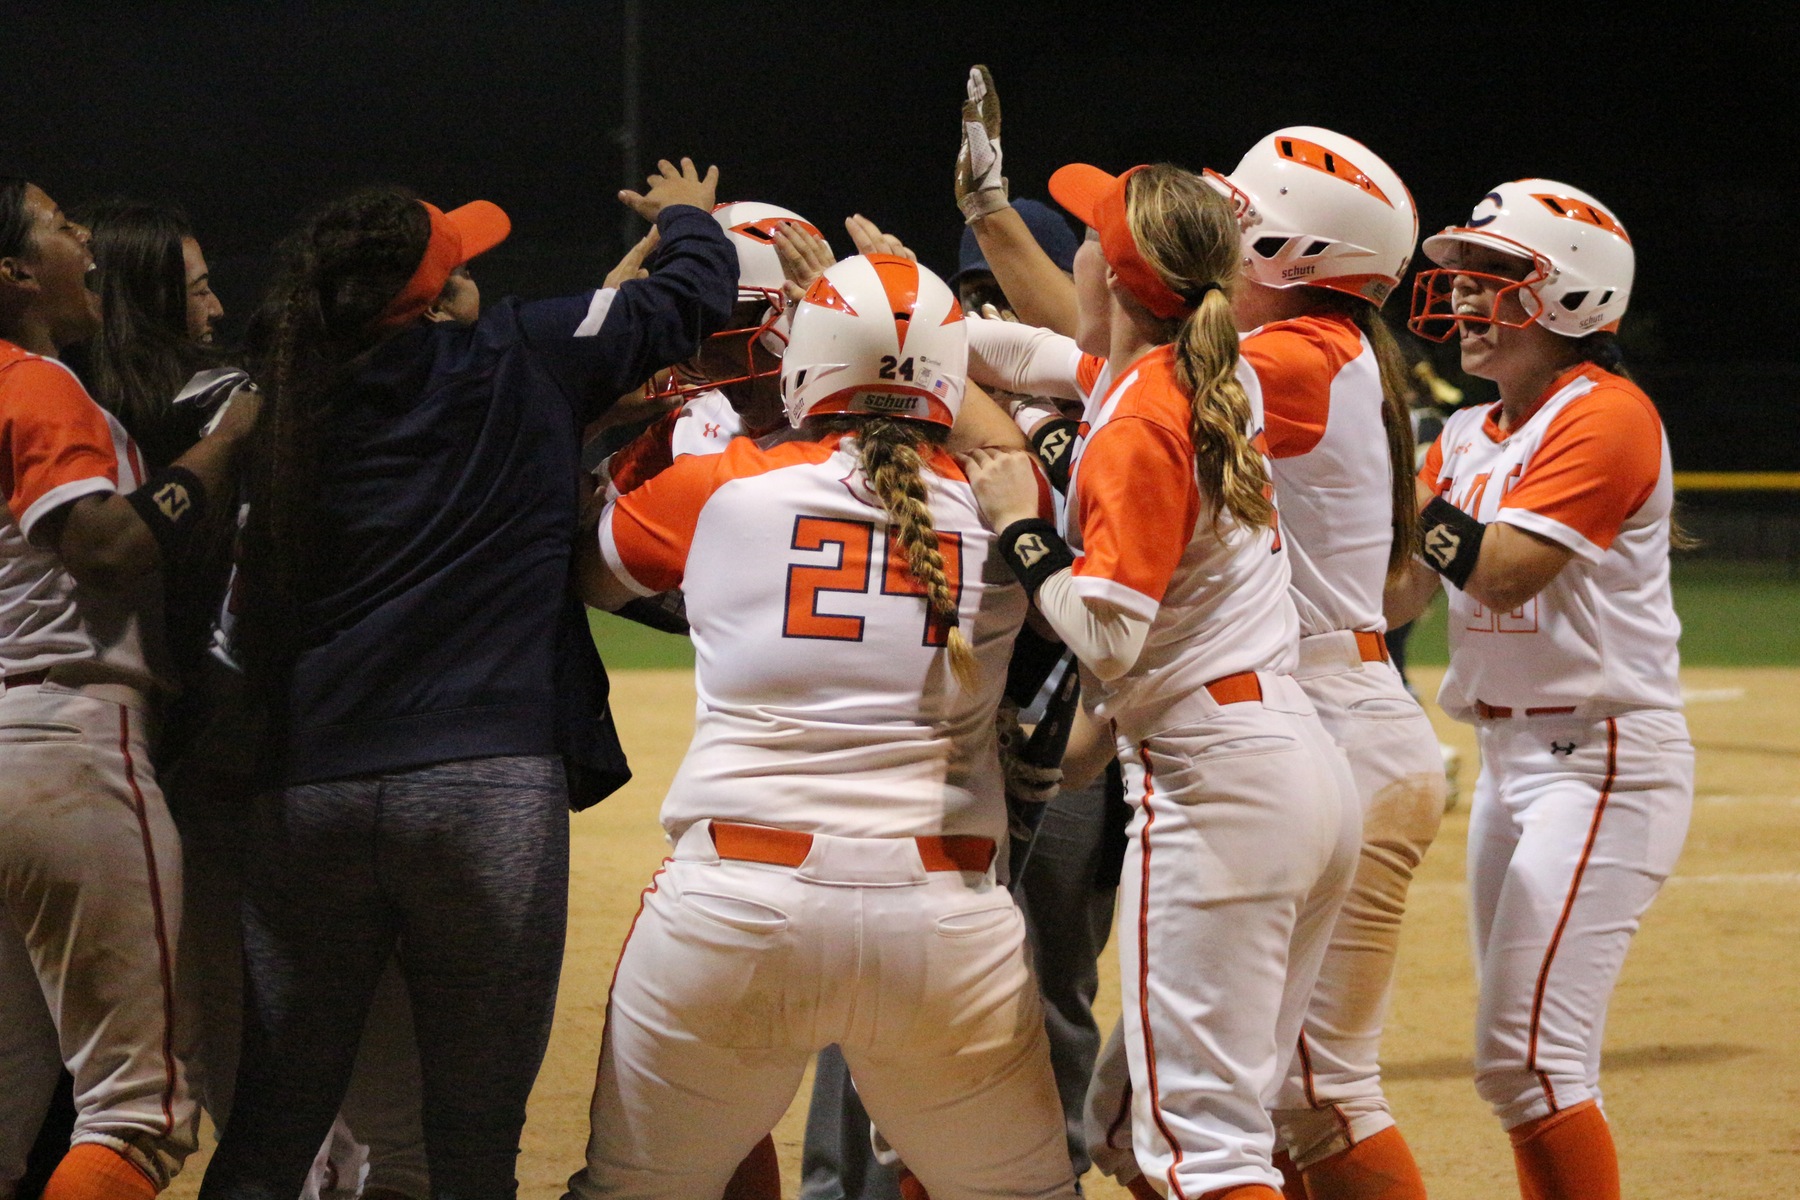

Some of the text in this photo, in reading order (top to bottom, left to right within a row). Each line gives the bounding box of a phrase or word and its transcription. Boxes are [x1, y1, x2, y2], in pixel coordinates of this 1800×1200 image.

[1281, 265, 1316, 279] schutt
[879, 355, 915, 382] 24
[864, 393, 919, 410] schutt
[1042, 430, 1068, 462] N
[1017, 535, 1045, 563] N
[1428, 530, 1455, 562] N
[782, 514, 964, 648] 24
